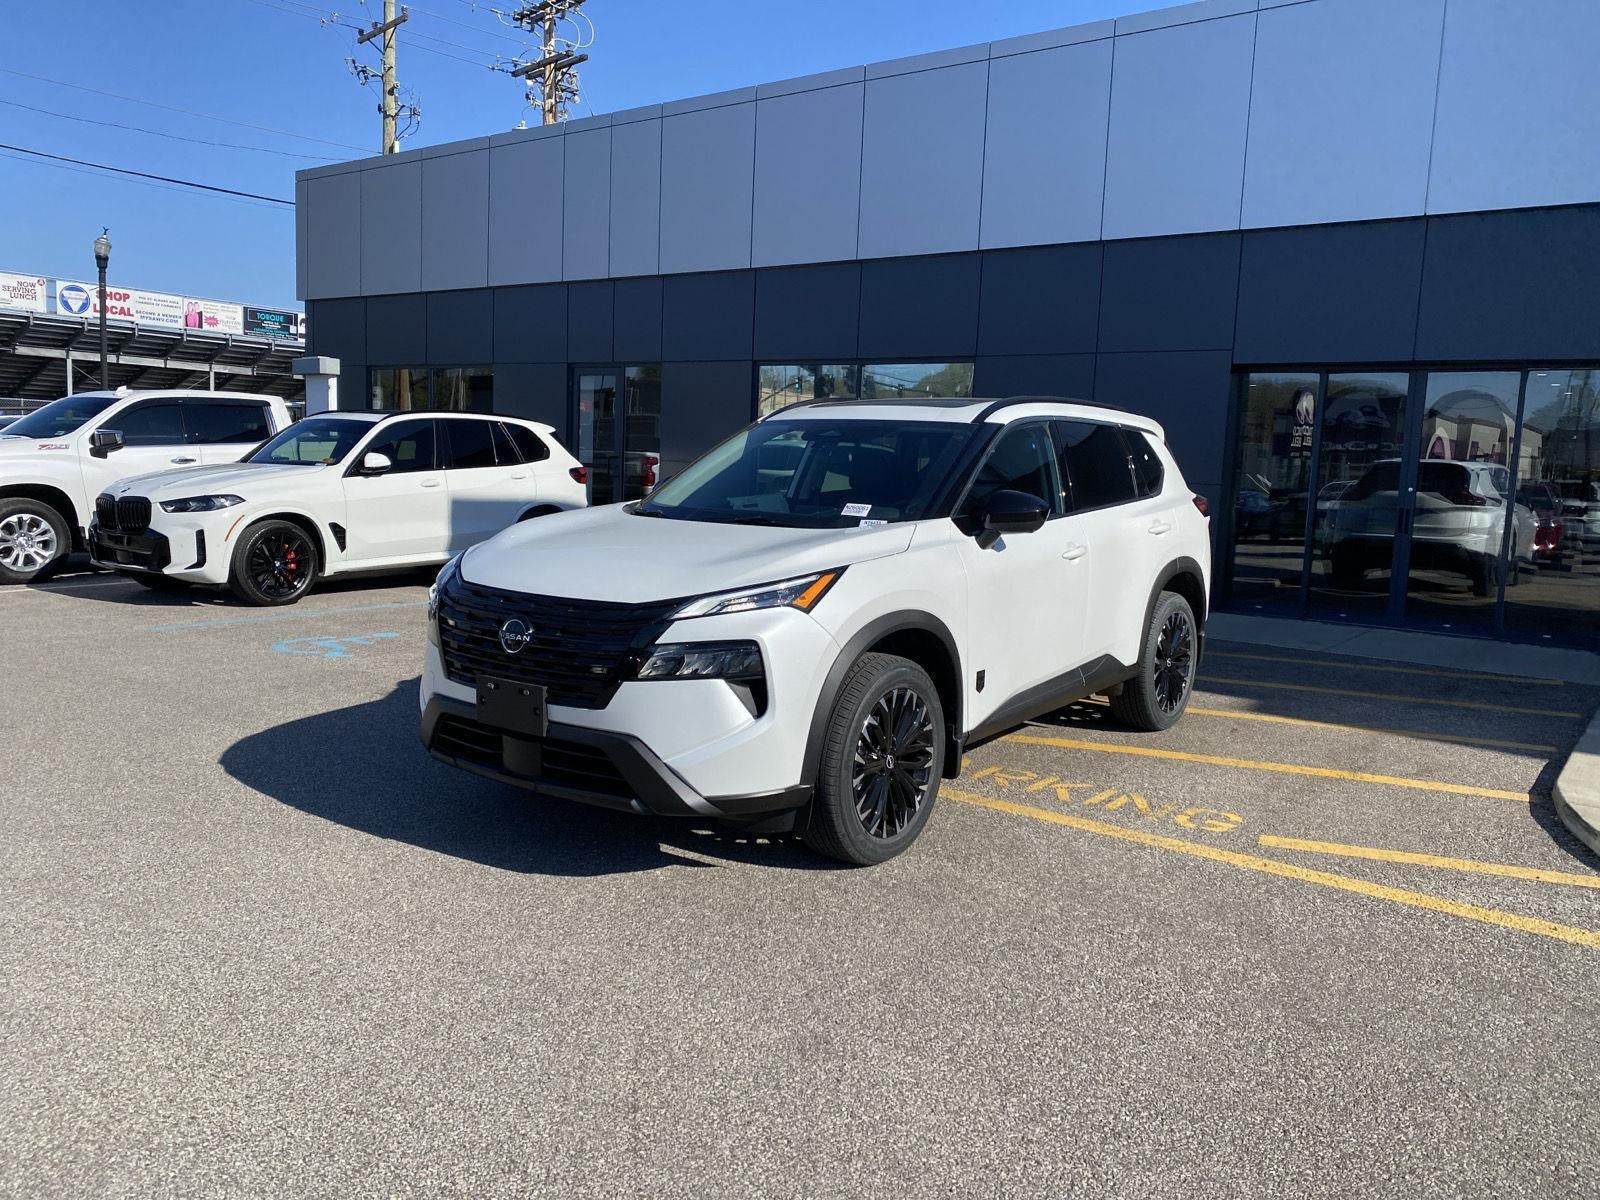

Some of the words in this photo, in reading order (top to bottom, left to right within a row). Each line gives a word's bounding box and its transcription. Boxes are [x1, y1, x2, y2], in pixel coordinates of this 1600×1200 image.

[2, 284, 36, 294] SERVING
[10, 292, 37, 300] LUNCH
[256, 313, 284, 322] TORQUE
[960, 755, 1243, 833] RKING
